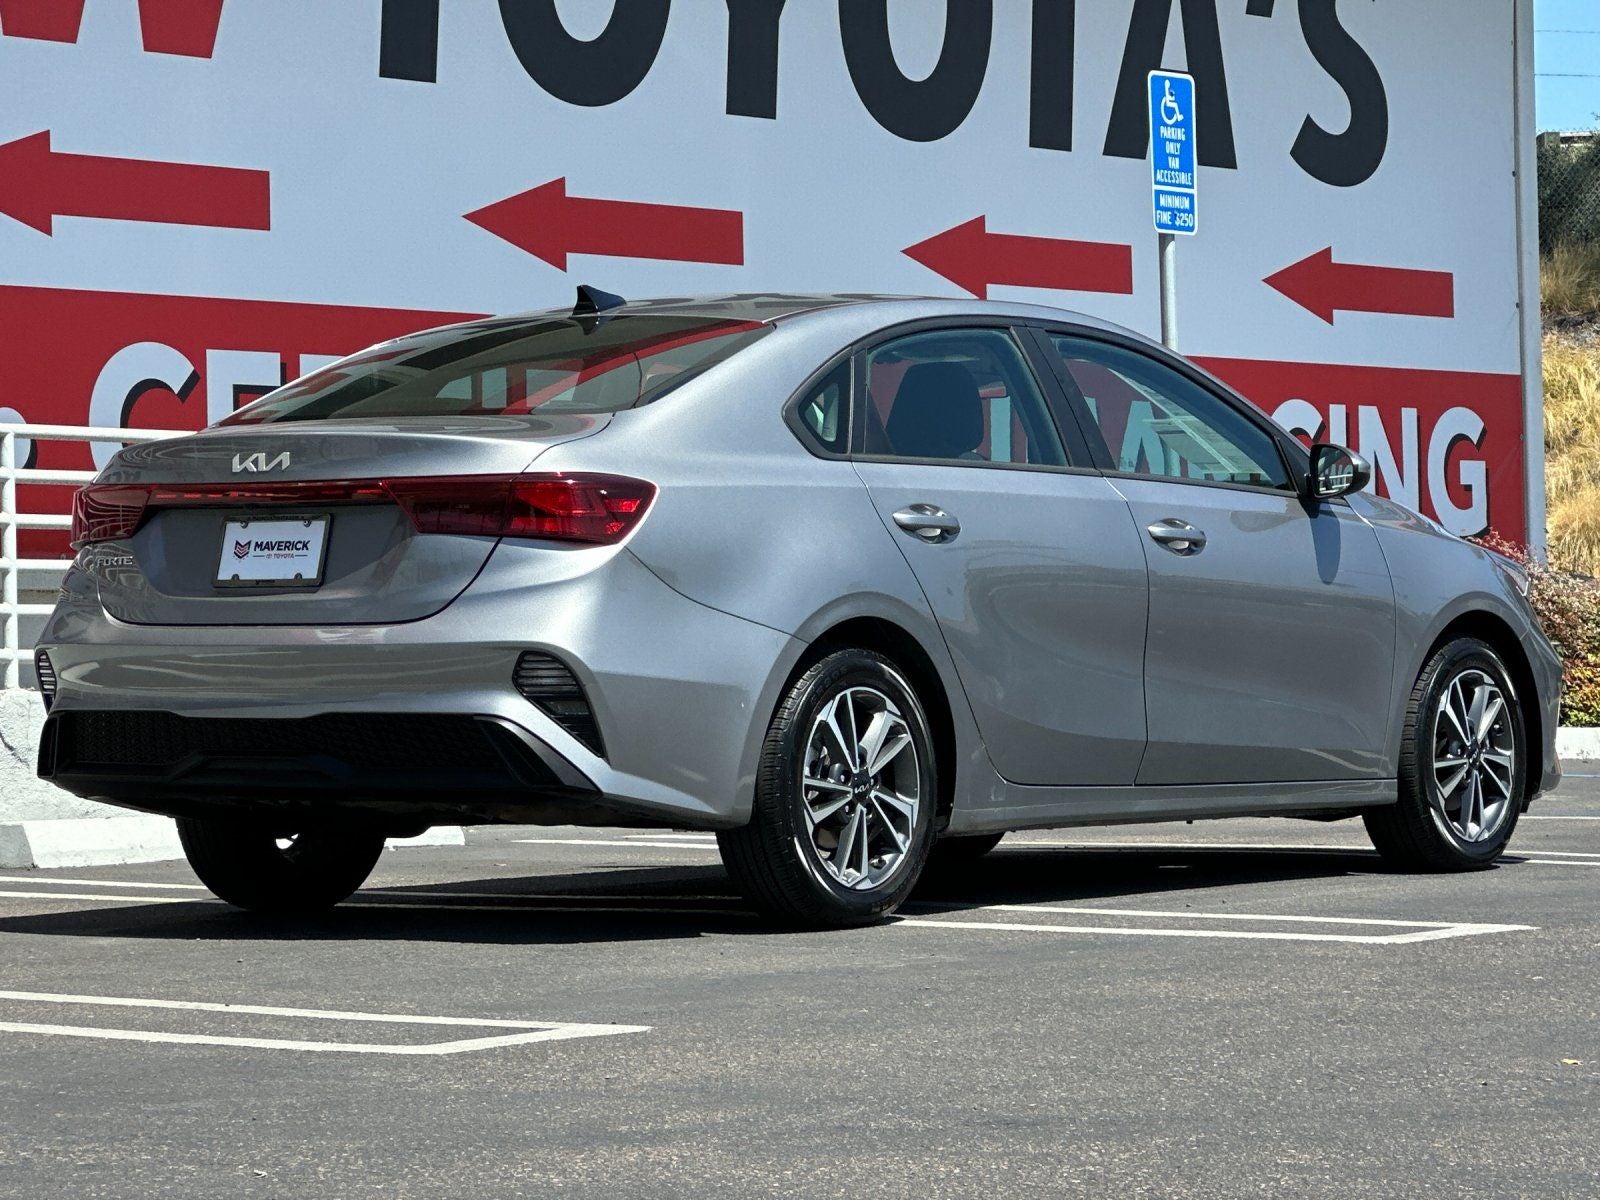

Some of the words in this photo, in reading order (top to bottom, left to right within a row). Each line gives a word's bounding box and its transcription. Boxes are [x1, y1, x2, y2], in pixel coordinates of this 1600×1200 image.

[1160, 126, 1186, 141] PARKING
[1165, 142, 1181, 156] ONLY
[1168, 156, 1180, 170] VAN
[1156, 171, 1193, 186] ACCESSIBLE
[1159, 193, 1190, 211] MINIMUM
[1156, 210, 1173, 225] FINE
[1174, 212, 1194, 228] $250
[232, 452, 291, 473] KIA
[254, 540, 311, 552] MAVERICK
[97, 556, 134, 567] FORTE
